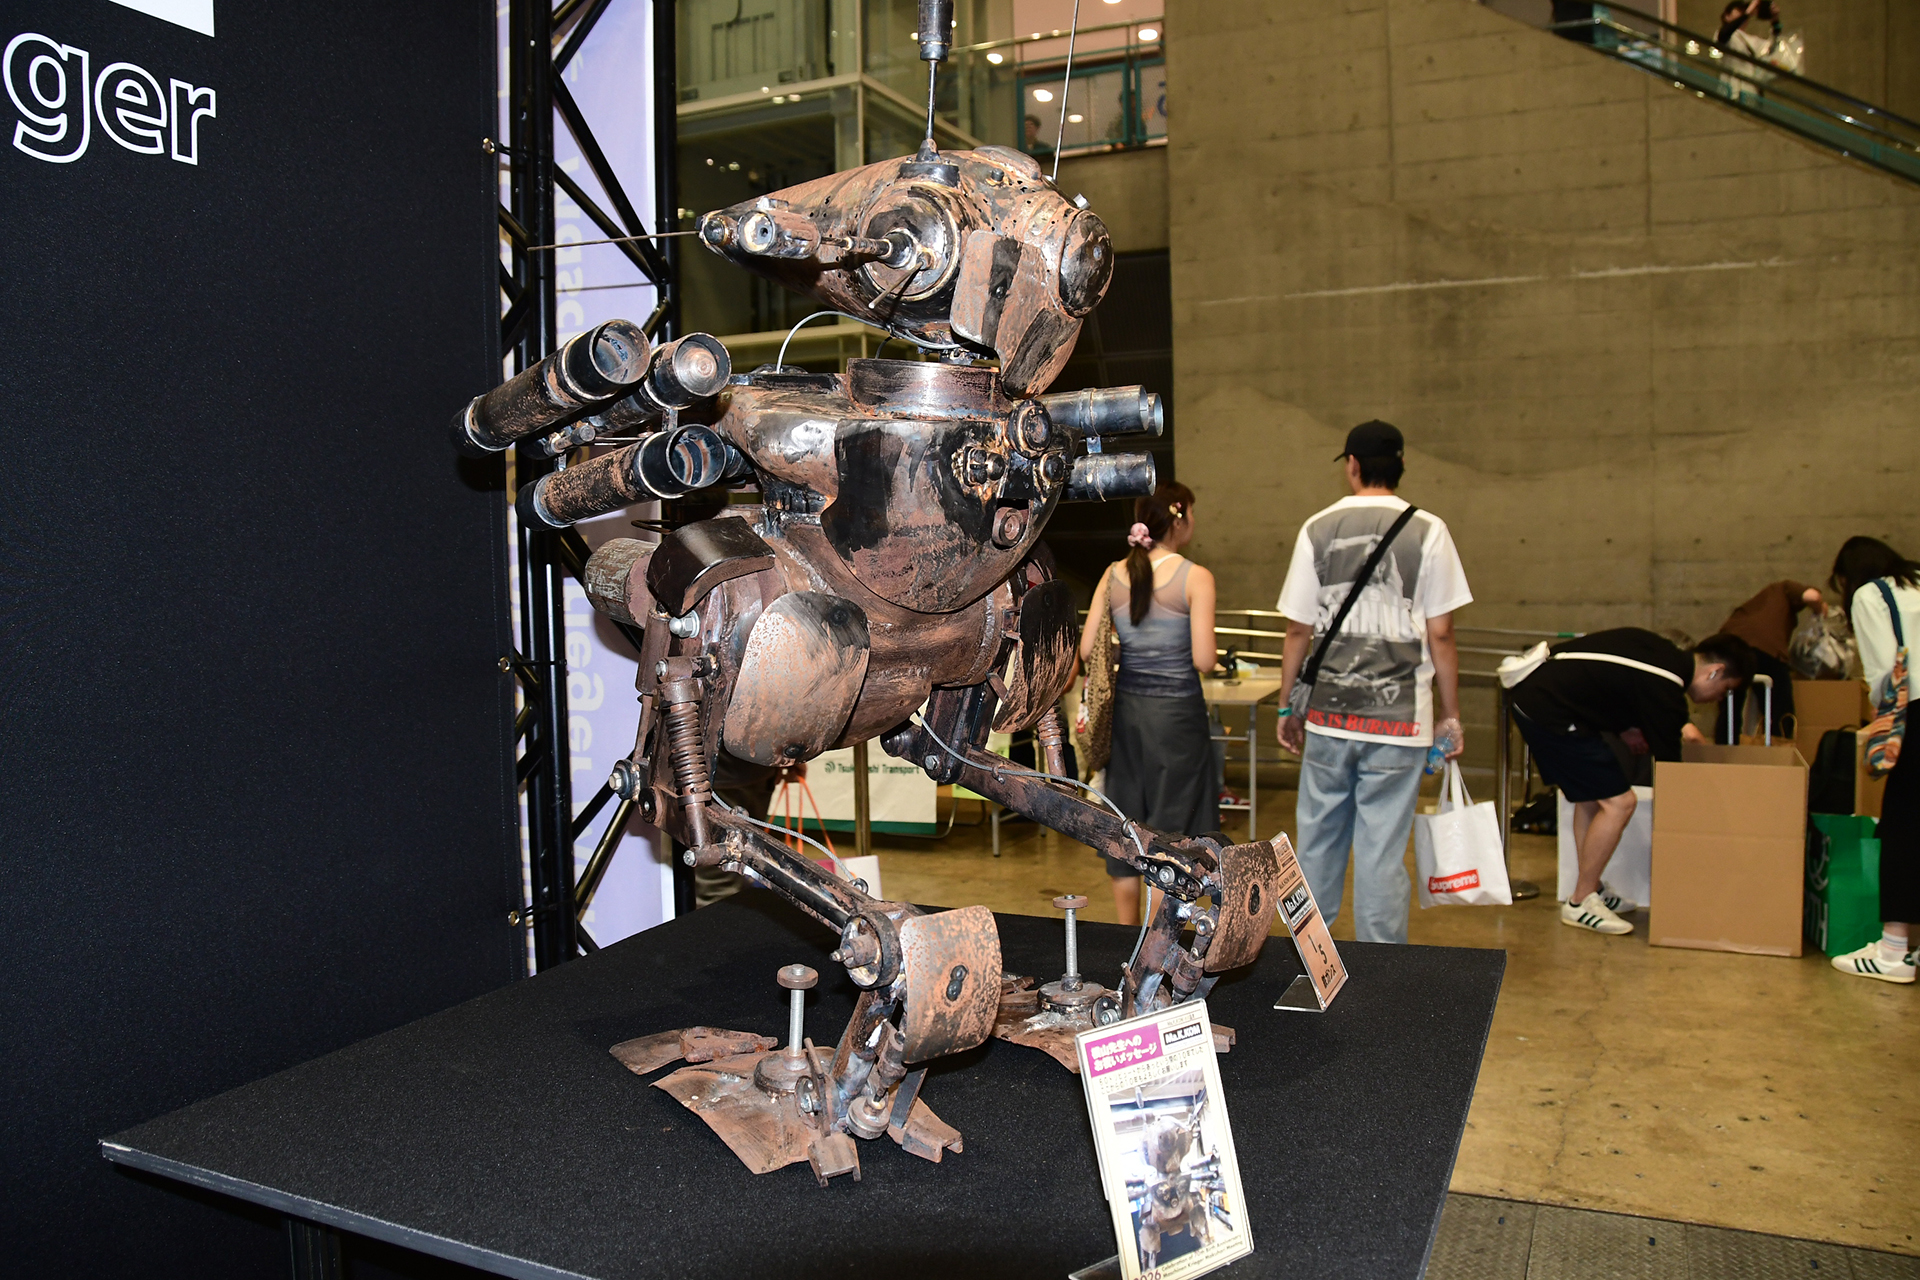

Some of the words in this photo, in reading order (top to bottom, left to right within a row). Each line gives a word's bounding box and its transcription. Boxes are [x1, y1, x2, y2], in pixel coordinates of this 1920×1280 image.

[3, 33, 216, 165] ger
[1327, 713, 1343, 728] IS
[1344, 714, 1421, 737] BURNING
[882, 763, 920, 776] Transport
[1431, 874, 1478, 892] Supreme
